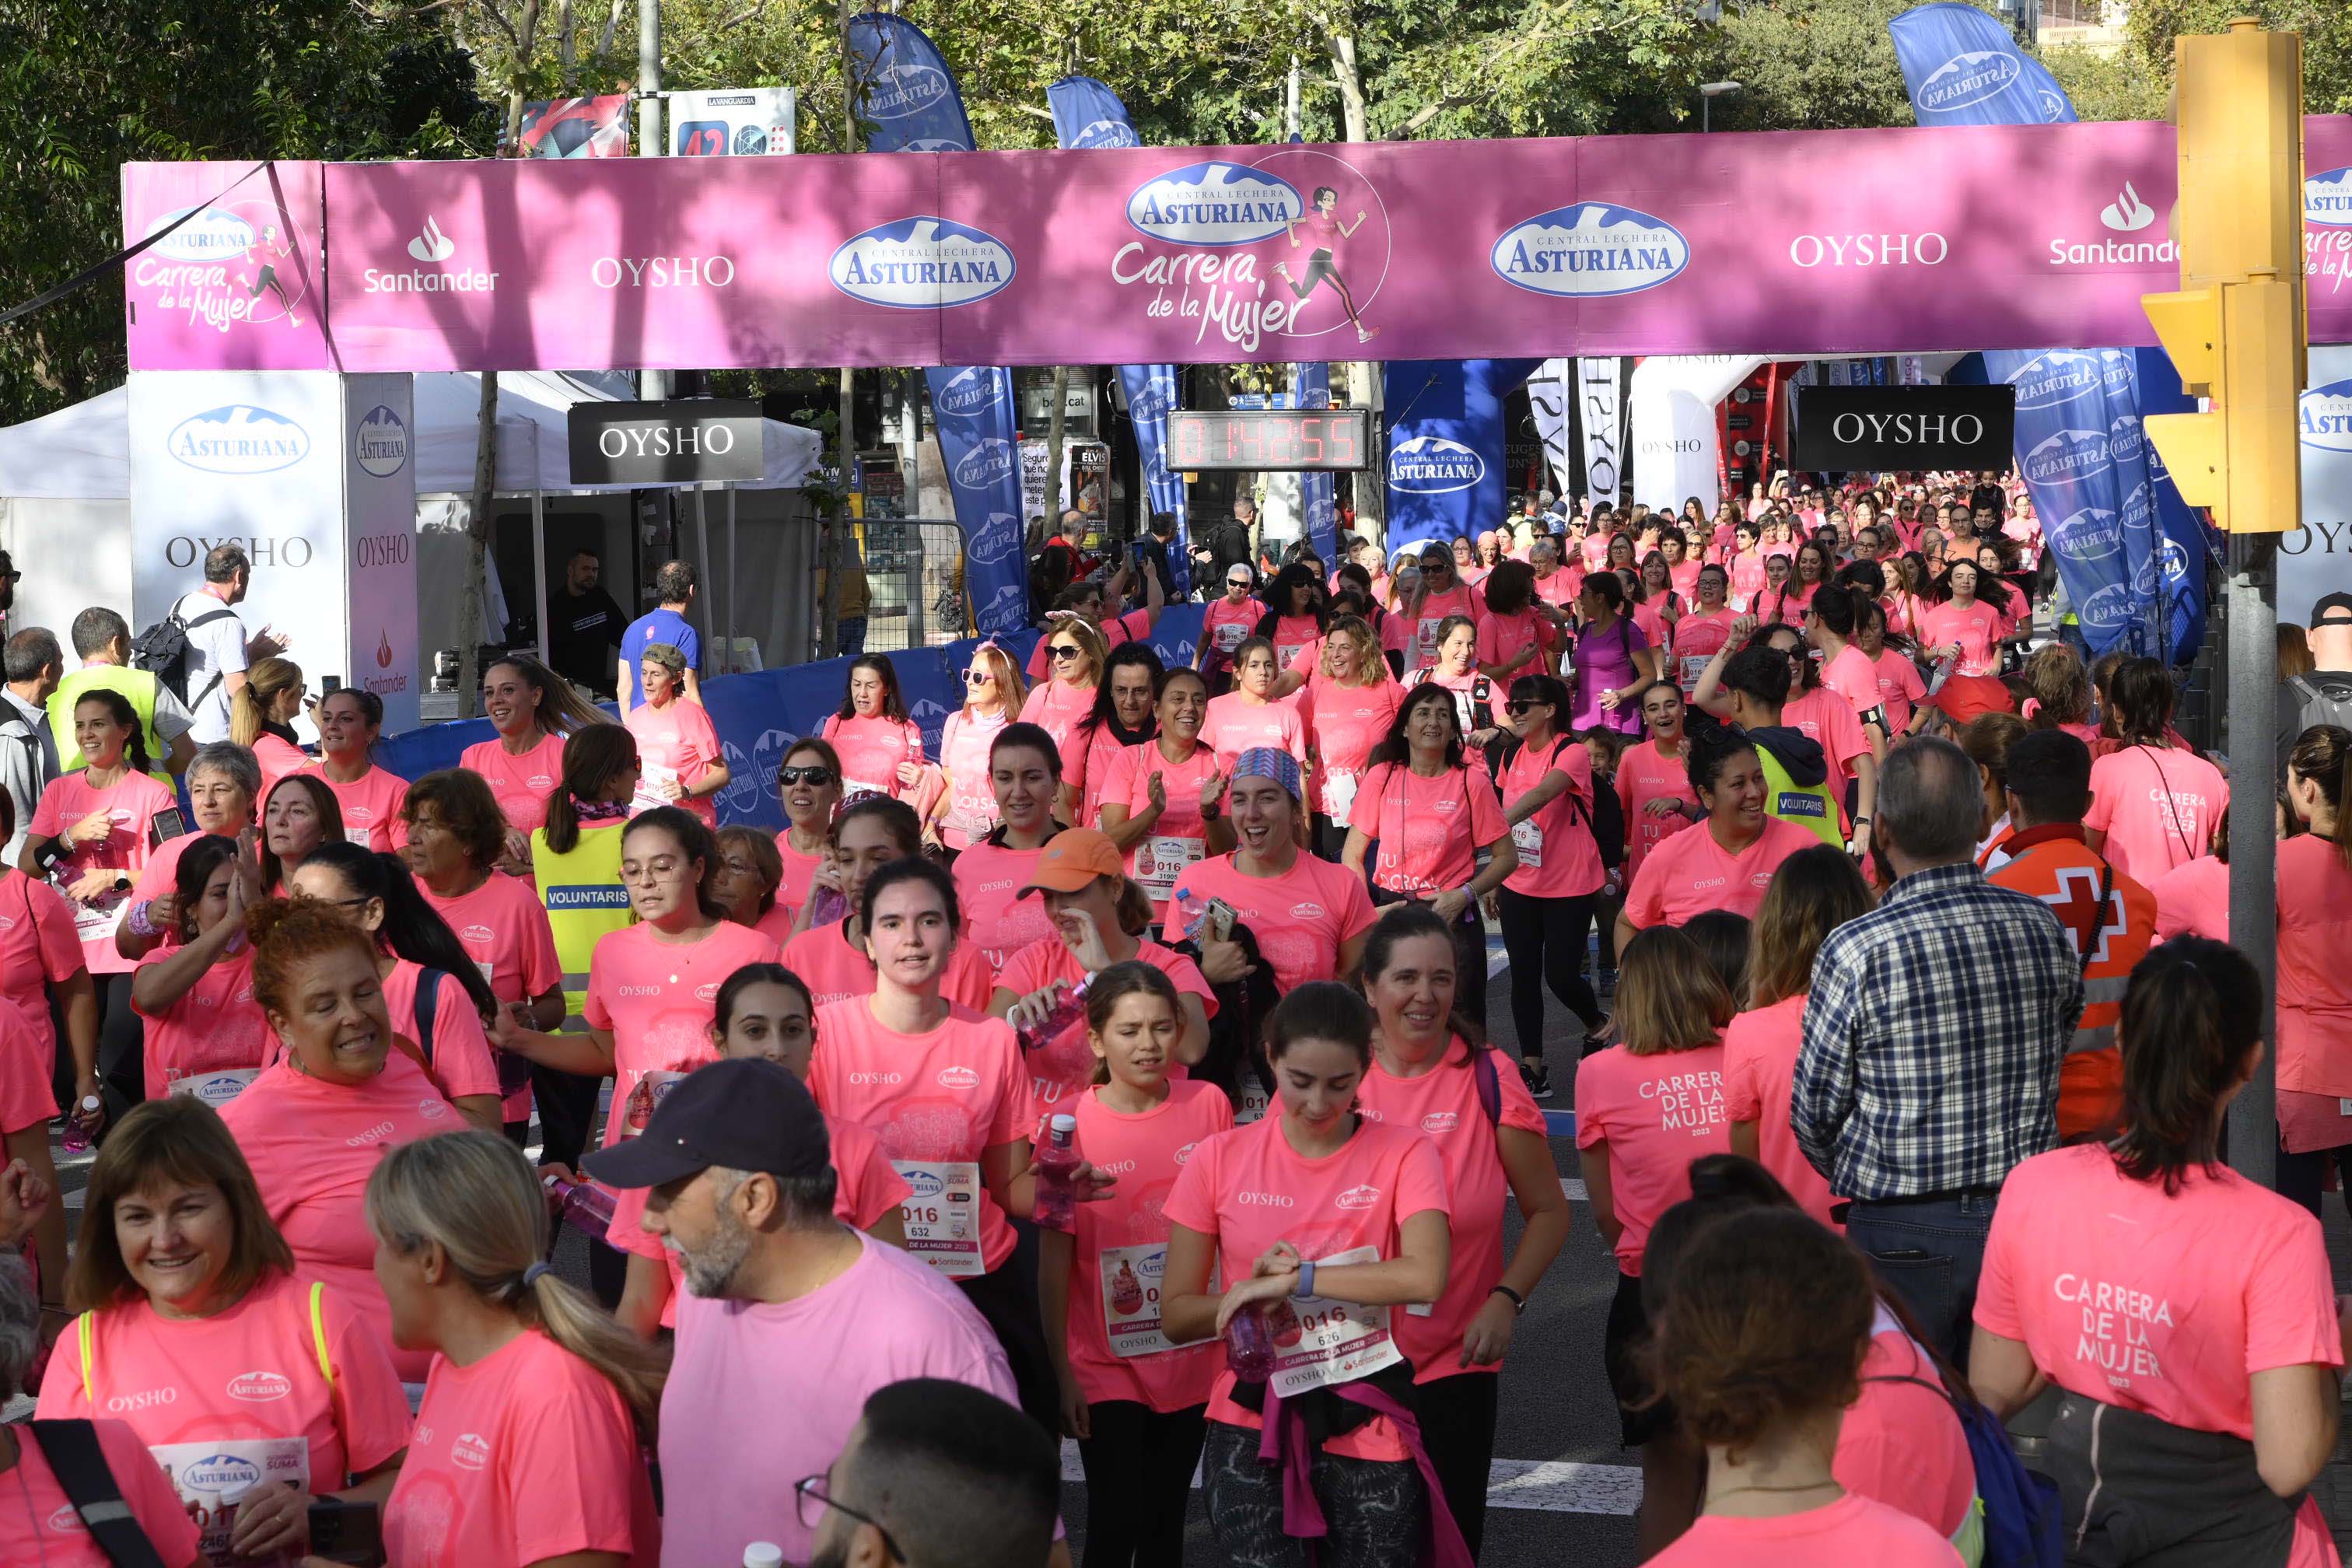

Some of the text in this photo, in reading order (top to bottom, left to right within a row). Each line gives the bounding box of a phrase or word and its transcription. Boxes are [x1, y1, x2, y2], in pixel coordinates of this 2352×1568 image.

[717, 96, 754, 105] VANGUARDIA
[1167, 190, 1284, 199] CENTRAL LECHERA
[1139, 194, 1289, 225] ASTURIANA
[1537, 234, 1668, 244] CENTRAL LECHERA
[936, 247, 995, 257] LECHERA
[1507, 239, 1674, 274] ASTURIANA
[1790, 233, 1948, 268] OYSHO
[135, 257, 227, 287] Carrera
[591, 256, 735, 288] OYSHO
[843, 251, 1002, 285] ASTURIANA
[1111, 241, 1257, 286] Carrera
[363, 267, 499, 293] Santander
[158, 289, 191, 308] de la
[1147, 286, 1199, 317] de la
[189, 284, 262, 333] Mujer
[1195, 278, 1311, 353] Mujer
[1832, 412, 1983, 444] OYSHO
[179, 431, 300, 457] ASTURIANA
[359, 434, 404, 460] ASTURIANA
[599, 424, 733, 457] OYSHO
[1179, 418, 1353, 462] 01:42:55
[1642, 439, 1701, 454] OYSHO
[1082, 452, 1106, 462] ELVIS
[1024, 467, 1036, 476] que
[1390, 460, 1477, 481] ASTURIANA
[357, 534, 409, 568] OYSHO
[363, 672, 407, 695] Santander
[2150, 789, 2207, 808] CARRERA
[2179, 806, 2193, 819] LA
[1512, 829, 1527, 838] 016
[1642, 824, 1659, 838] TU
[1157, 862, 1181, 871] 016
[1380, 852, 1397, 868] TU
[980, 880, 1013, 893] OYSHO
[1694, 877, 1725, 890] OYSHO
[548, 891, 628, 904] VOLUNTARIS
[463, 931, 493, 940] ASTURIANA
[619, 985, 660, 996] OYSHO
[811, 992, 853, 1003] OYSHO
[849, 1072, 901, 1085] OYSHO
[939, 1074, 978, 1085] ASTURIANA
[1639, 1072, 1724, 1099] CARRER
[203, 1087, 243, 1096] ASTURIANA
[1034, 1077, 1062, 1104] TU
[1661, 1090, 1724, 1111] DE LA
[1662, 1106, 1726, 1132] MUJE
[347, 1121, 395, 1148] OYSHO
[1692, 1128, 1710, 1136] 2023
[1238, 1192, 1294, 1207] OYSHO
[1340, 1191, 1378, 1206] ASTURIANA
[902, 1207, 938, 1222] 016
[912, 1227, 929, 1237] 632
[2054, 1274, 2174, 1327] CARRERA
[1122, 1323, 1155, 1332] CARRERA
[1304, 1307, 1346, 1331] 016
[2083, 1307, 2151, 1349] DE LA
[1120, 1336, 1157, 1349] OYSHO
[1318, 1332, 1339, 1346] 626
[1286, 1353, 1318, 1367] CARRERA
[1342, 1341, 1365, 1353] MUJER
[1353, 1350, 1388, 1367] Santander
[2076, 1334, 2162, 1378] MUJER
[1286, 1369, 1325, 1386] OYSHO
[233, 1382, 285, 1395] ASTURIANA
[108, 1387, 176, 1412] OYSHO
[267, 1461, 299, 1470] SUMA
[189, 1470, 253, 1483] ASTURIANA
